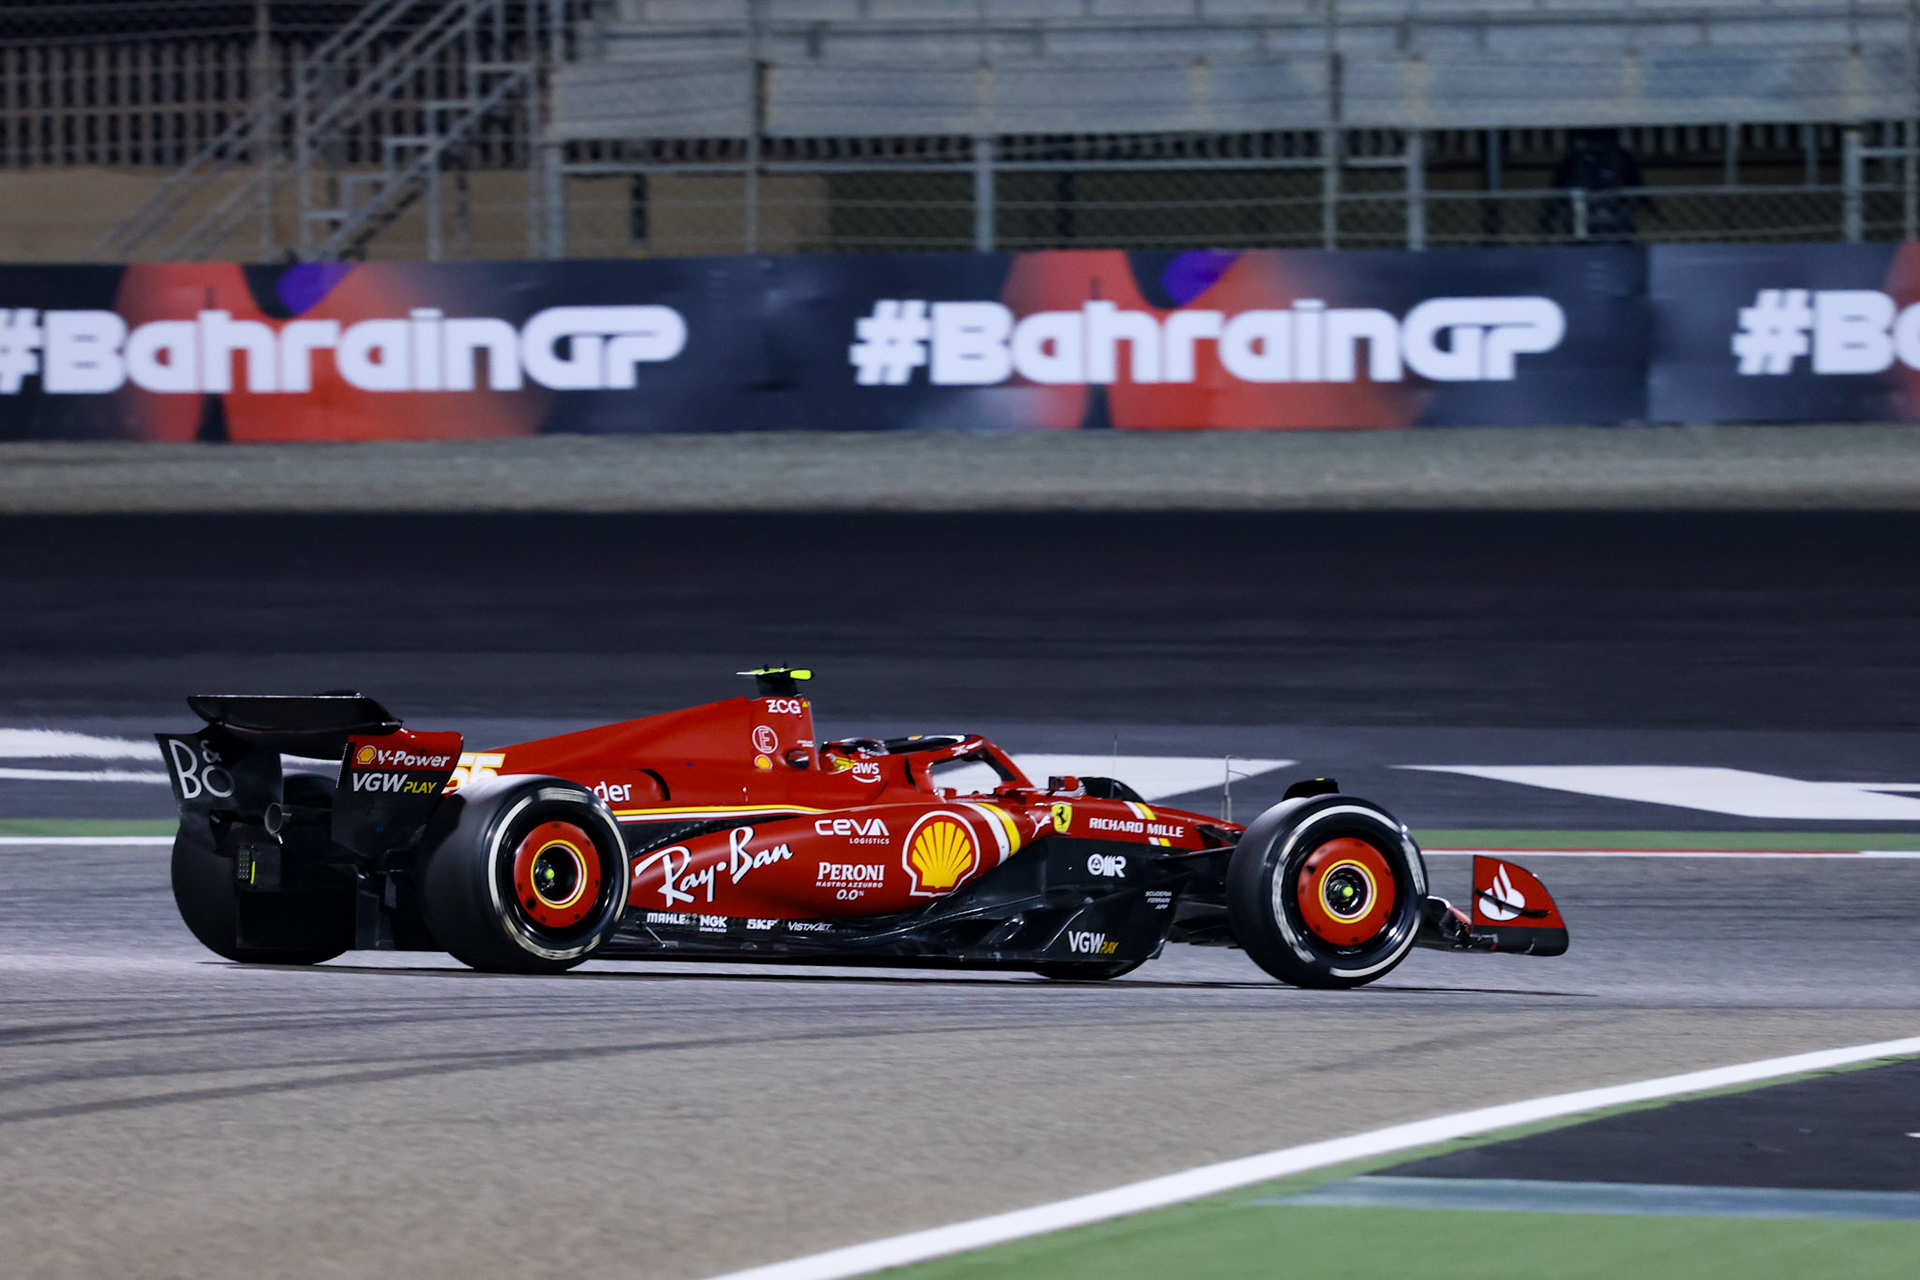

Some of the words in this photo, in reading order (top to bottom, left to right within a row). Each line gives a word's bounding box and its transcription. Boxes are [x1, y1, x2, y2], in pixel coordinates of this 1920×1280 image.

[850, 295, 1566, 386] #BahrainGP
[765, 699, 801, 714] ZCG
[377, 749, 450, 768] V-Power
[352, 772, 408, 793] VGW
[403, 781, 437, 794] PLAY
[585, 780, 632, 803] der
[1089, 817, 1144, 834] RICHARD
[1147, 823, 1184, 838] MILLE
[849, 837, 890, 845] LOGISTICS
[817, 861, 885, 881] PERONI
[646, 912, 686, 925] MAHLE
[700, 915, 728, 928] NGK
[746, 918, 778, 931] SKF
[1068, 930, 1106, 953] VGW
